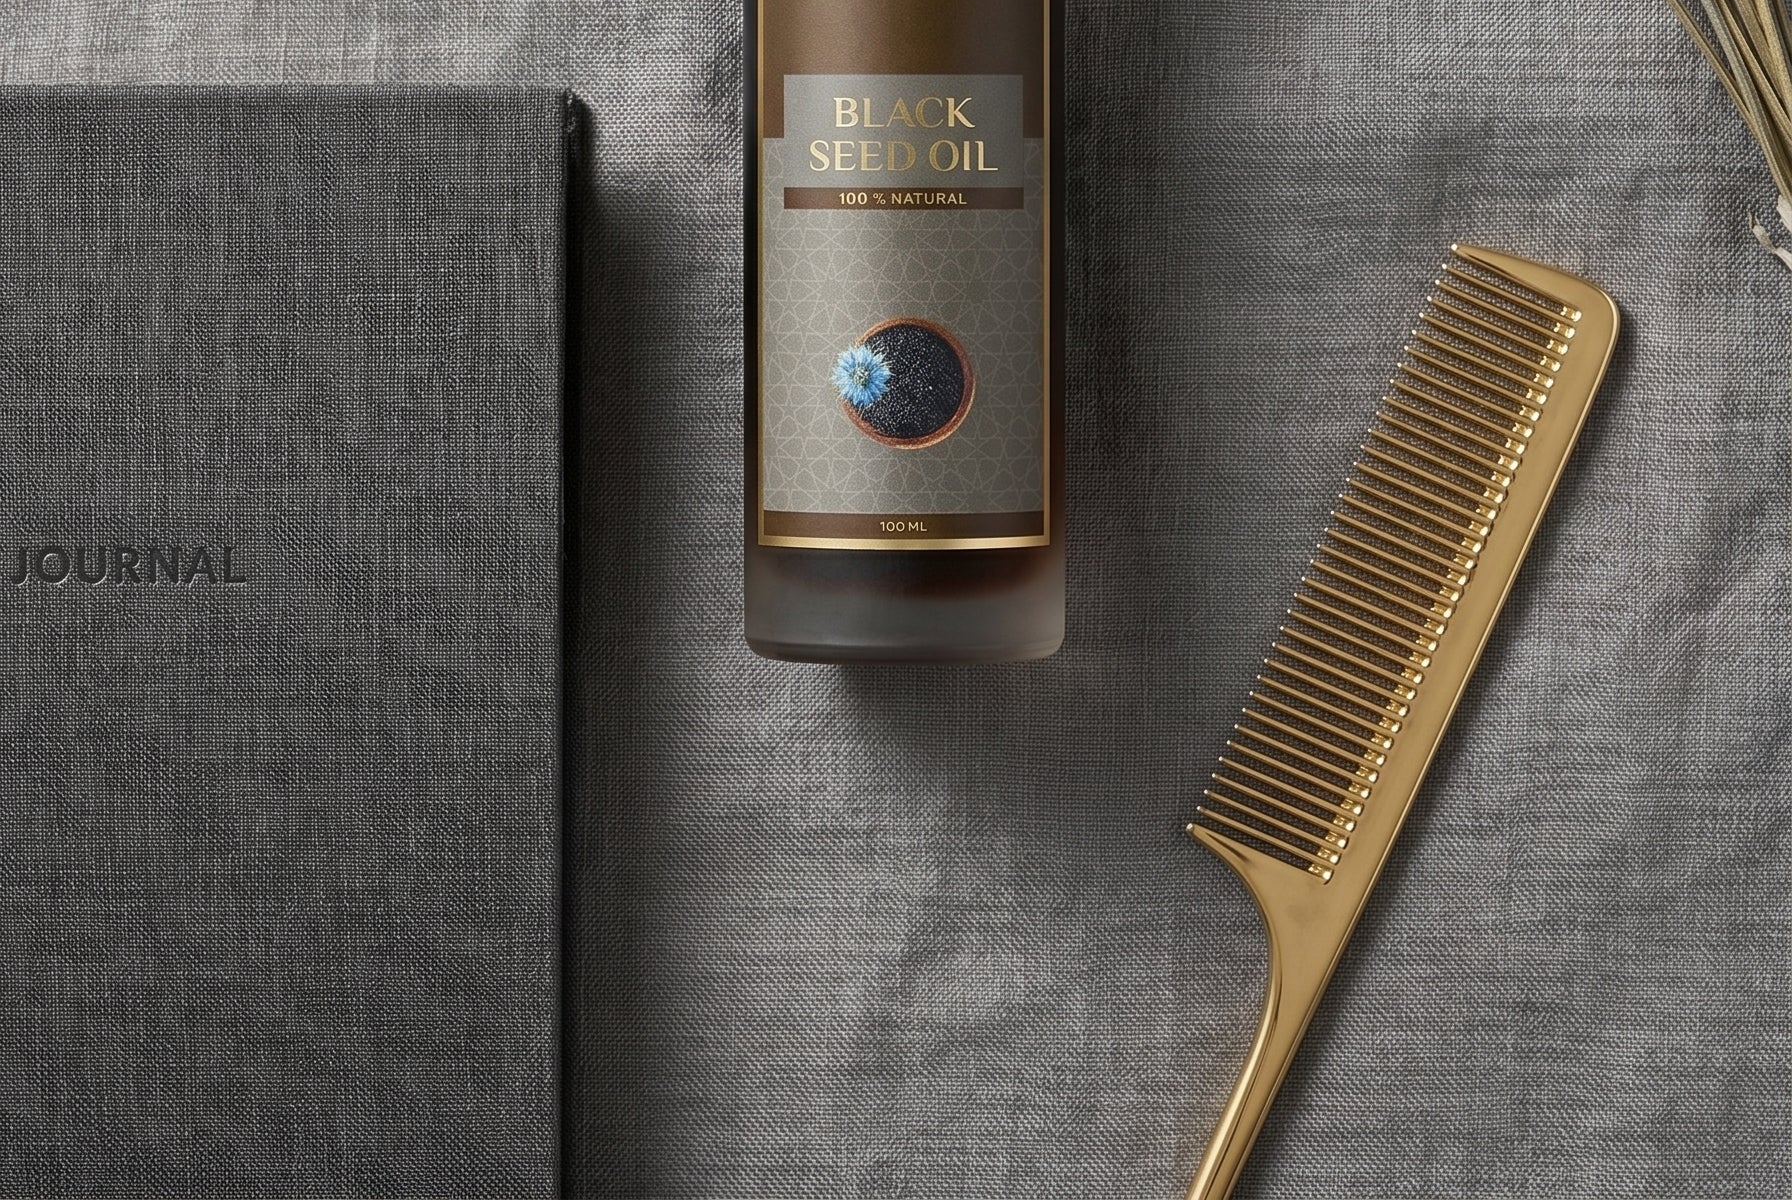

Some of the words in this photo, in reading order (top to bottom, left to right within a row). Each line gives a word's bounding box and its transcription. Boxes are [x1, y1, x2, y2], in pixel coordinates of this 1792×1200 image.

[833, 97, 976, 128] BLACK
[809, 140, 917, 171] SEED
[928, 140, 999, 171] OIL
[838, 192, 868, 205] 100
[872, 192, 886, 205] %
[891, 192, 968, 205] NATURAL
[879, 521, 905, 532] 100
[908, 521, 927, 532] ML
[12, 547, 247, 586] JOURNAL
